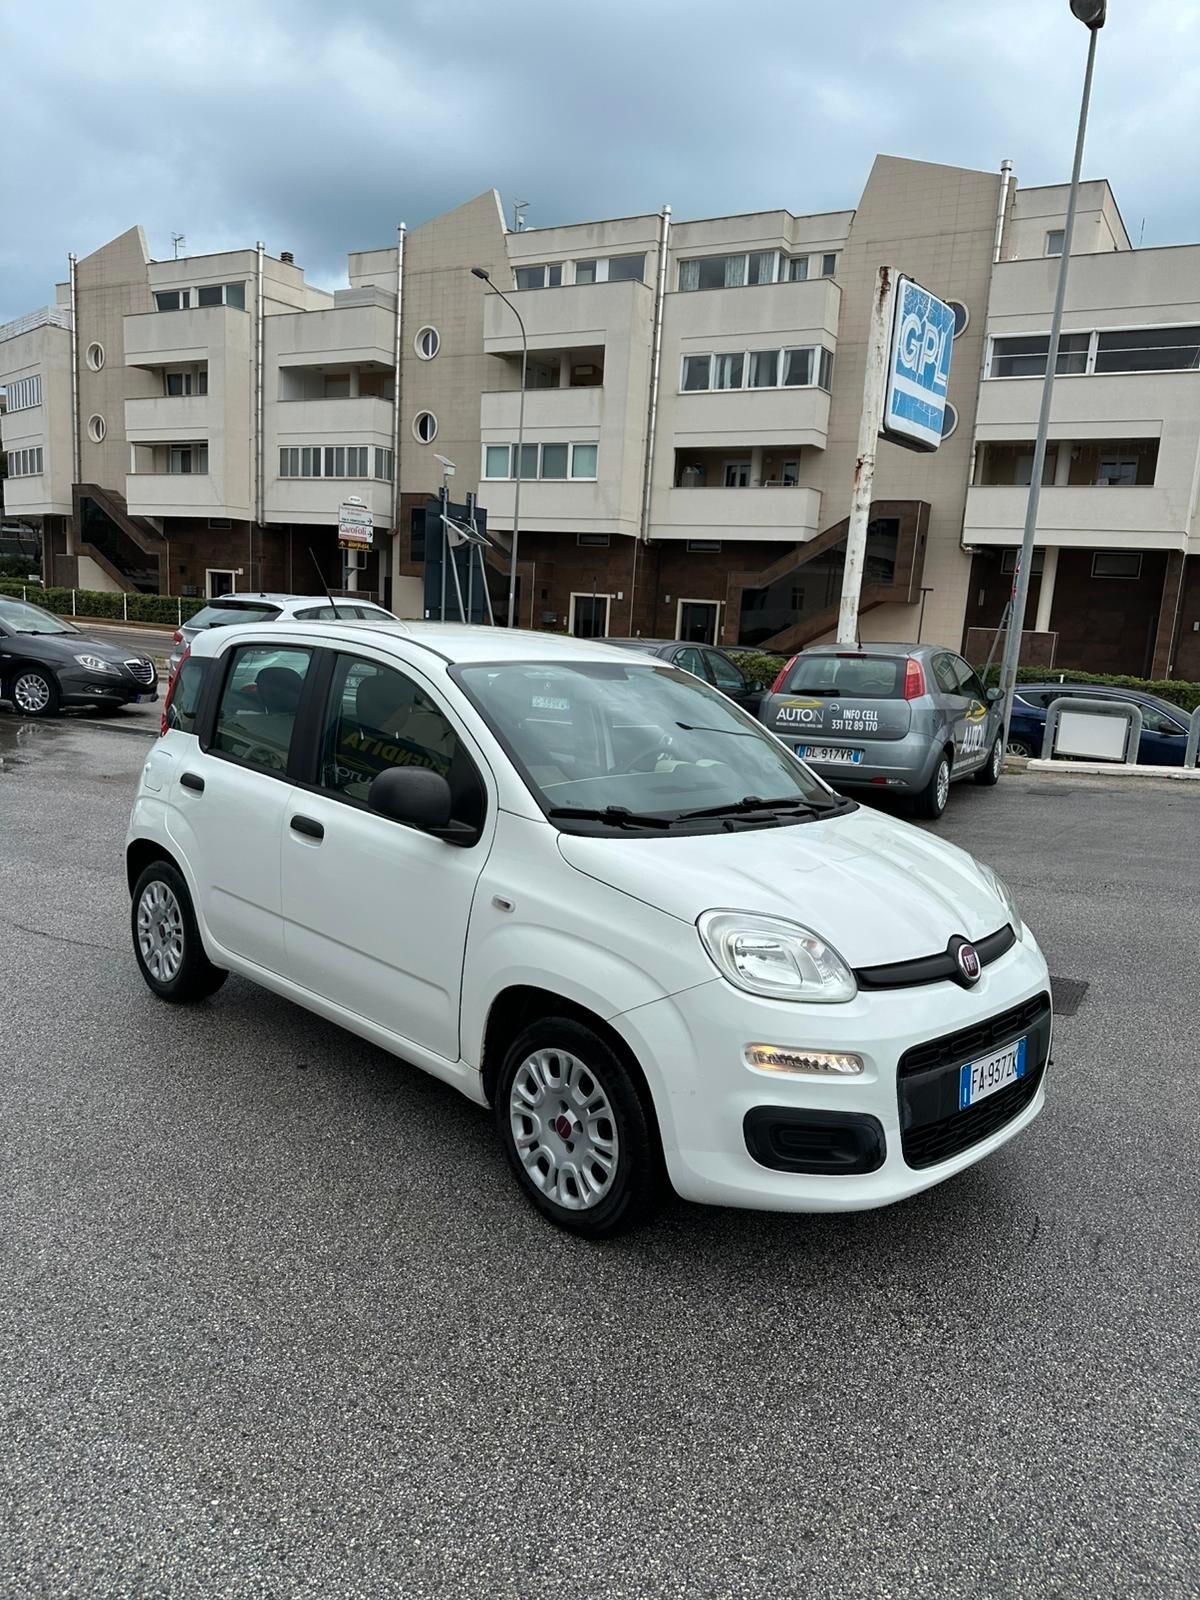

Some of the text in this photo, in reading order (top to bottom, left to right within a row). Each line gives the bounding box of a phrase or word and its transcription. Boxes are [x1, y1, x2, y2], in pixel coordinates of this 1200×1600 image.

[900, 313, 948, 387] GPL
[843, 709, 879, 721] INFO CELL
[831, 719, 843, 730] 331
[845, 720, 853, 730] 12
[853, 720, 864, 731] 89
[865, 721, 878, 732] 170
